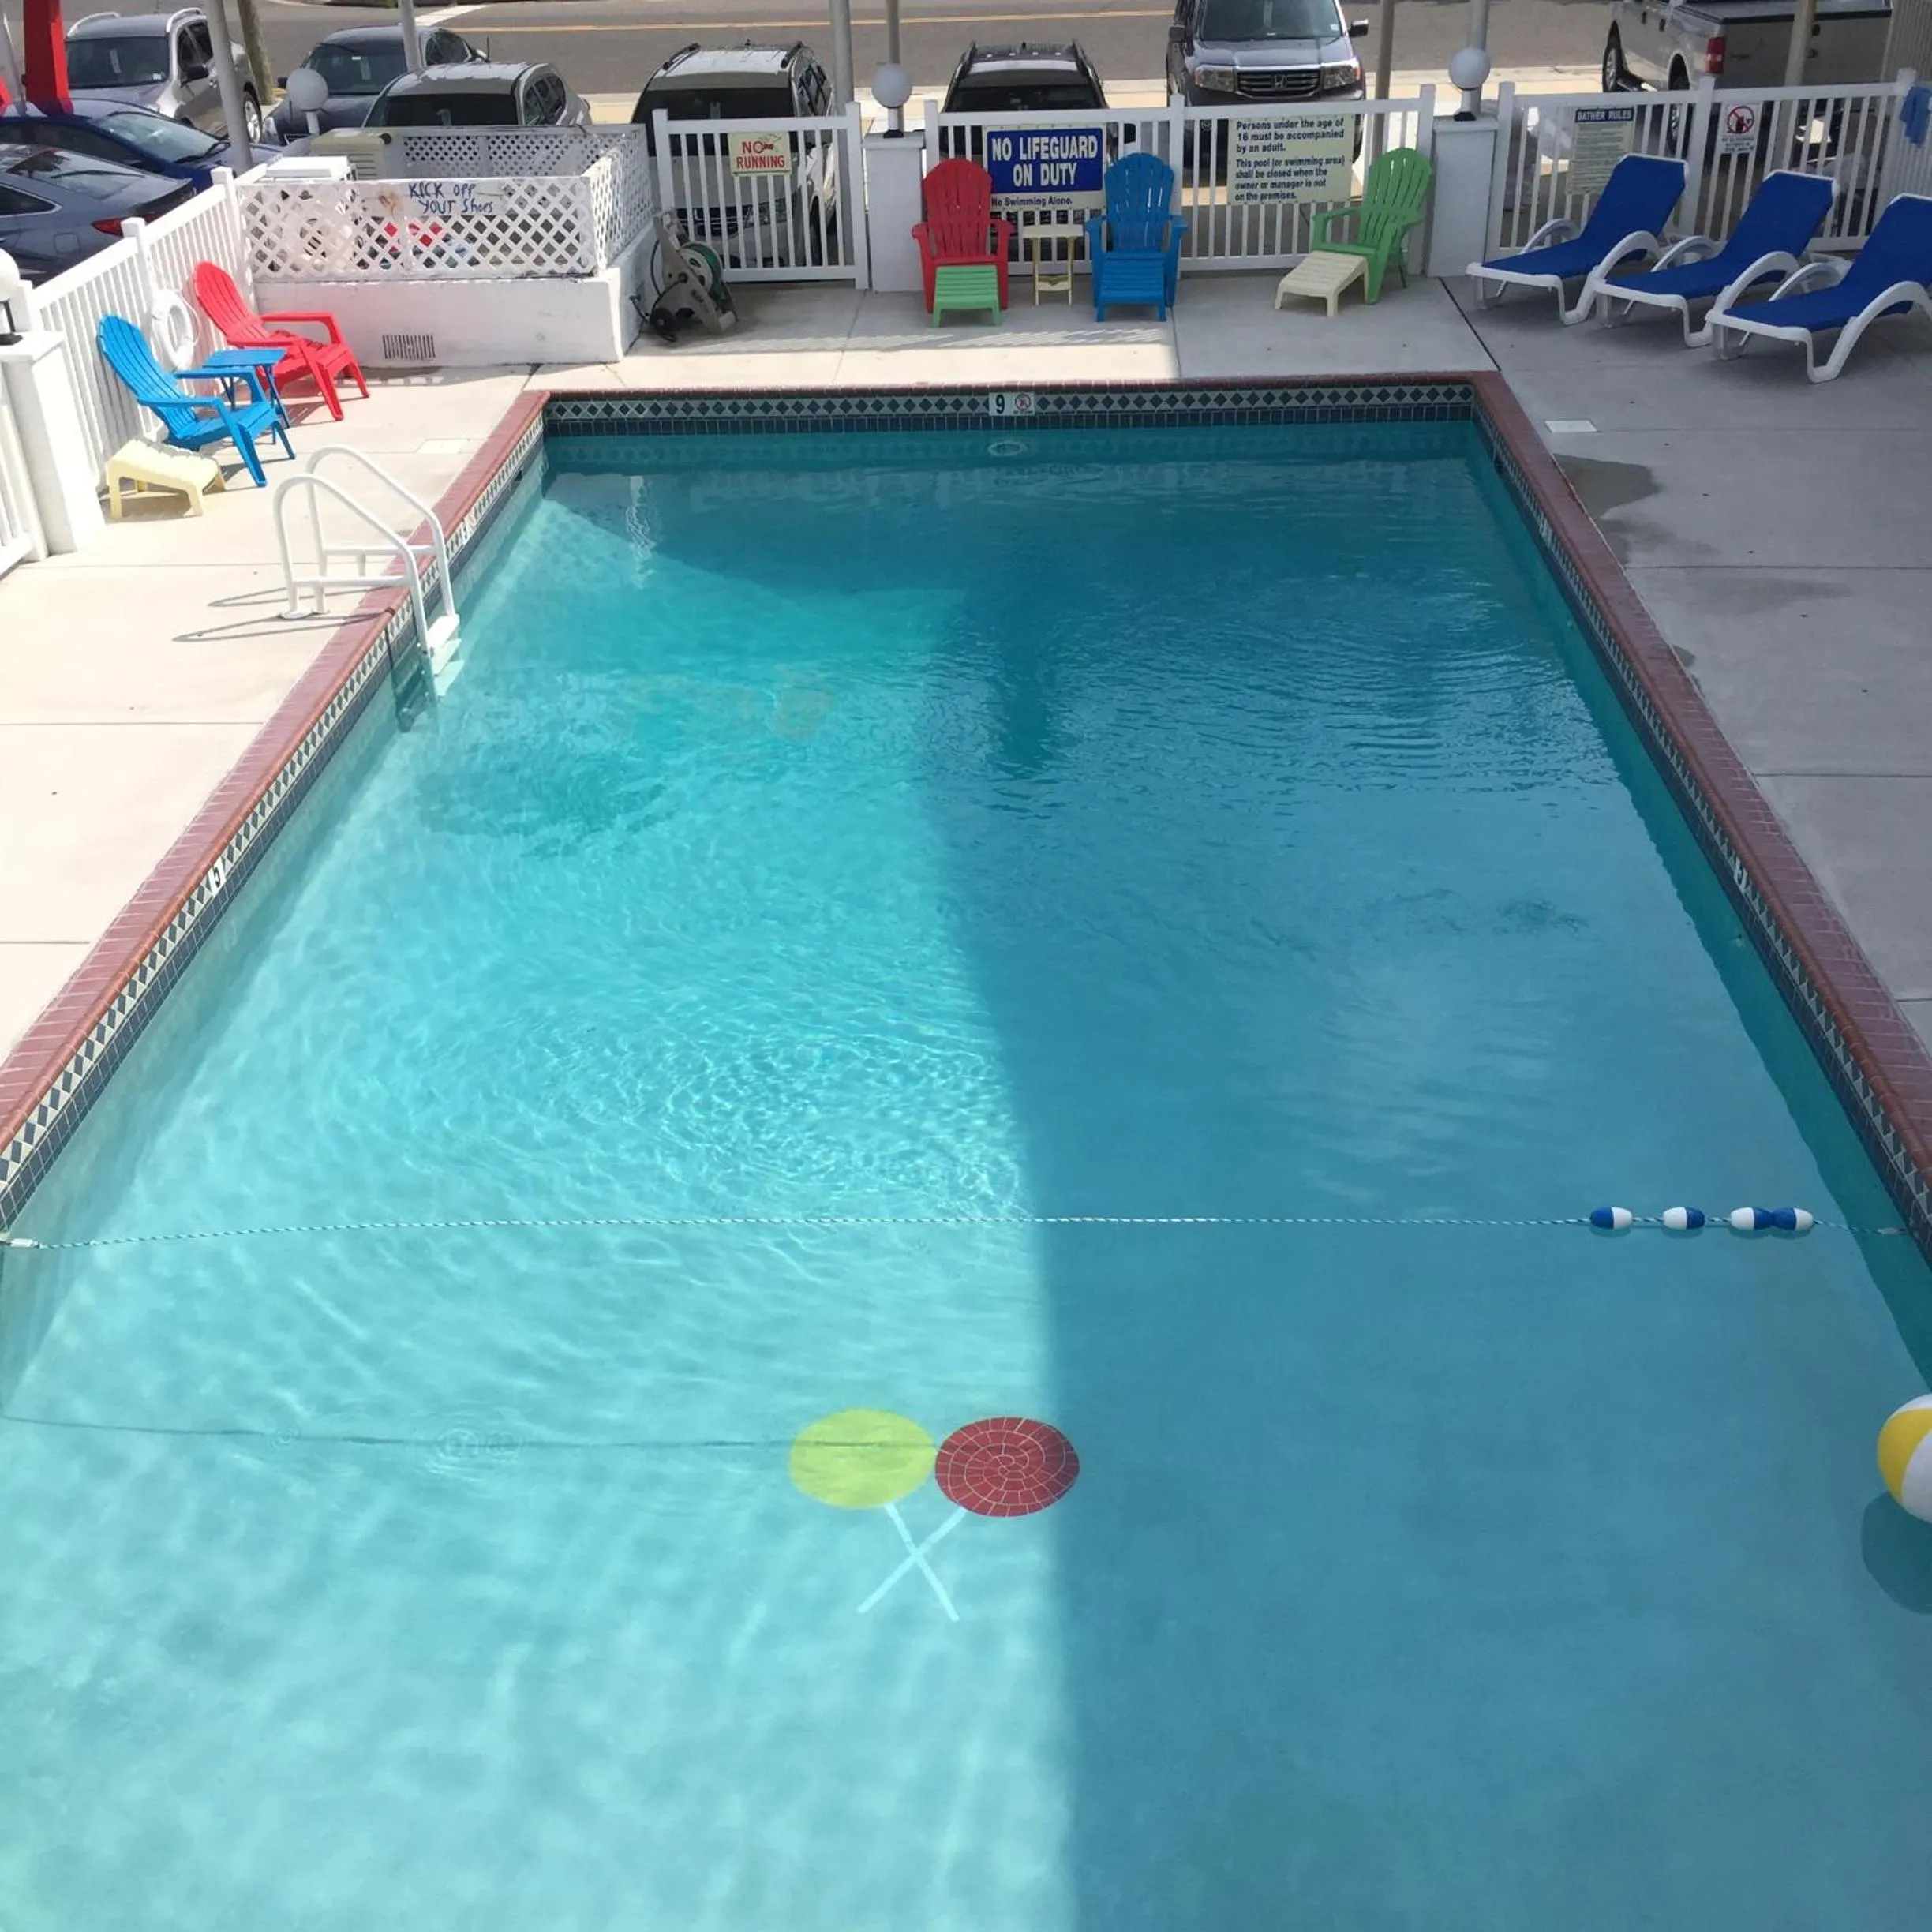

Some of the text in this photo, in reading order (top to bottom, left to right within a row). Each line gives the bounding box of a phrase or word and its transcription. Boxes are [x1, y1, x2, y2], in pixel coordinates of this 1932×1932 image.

[1608, 110, 1632, 120] RULES
[1237, 118, 1344, 130] Persons under the age of
[1238, 132, 1248, 141] 16
[1251, 132, 1271, 140] must
[1287, 129, 1344, 140] accompanied
[741, 140, 764, 154] NO
[991, 135, 1098, 161] NO LIFEGUARD
[1237, 144, 1246, 155] by
[1262, 143, 1286, 152] adult.
[736, 155, 785, 168] RUNNING
[1236, 159, 1252, 167] This
[1254, 158, 1270, 168] pool
[1285, 156, 1323, 167] swimming
[1013, 162, 1077, 187] ON DUTY
[1236, 170, 1254, 178] shall
[1267, 169, 1291, 178] closed
[1294, 168, 1314, 177] when
[1316, 167, 1327, 176] the
[408, 181, 444, 198] KICK
[1270, 181, 1303, 190] manager
[1305, 178, 1312, 187] is
[1313, 178, 1326, 187] not
[991, 195, 1073, 208] No Swimming Alone.
[1246, 191, 1258, 200] the
[1260, 191, 1297, 202] premises.
[996, 394, 1005, 414] 9
